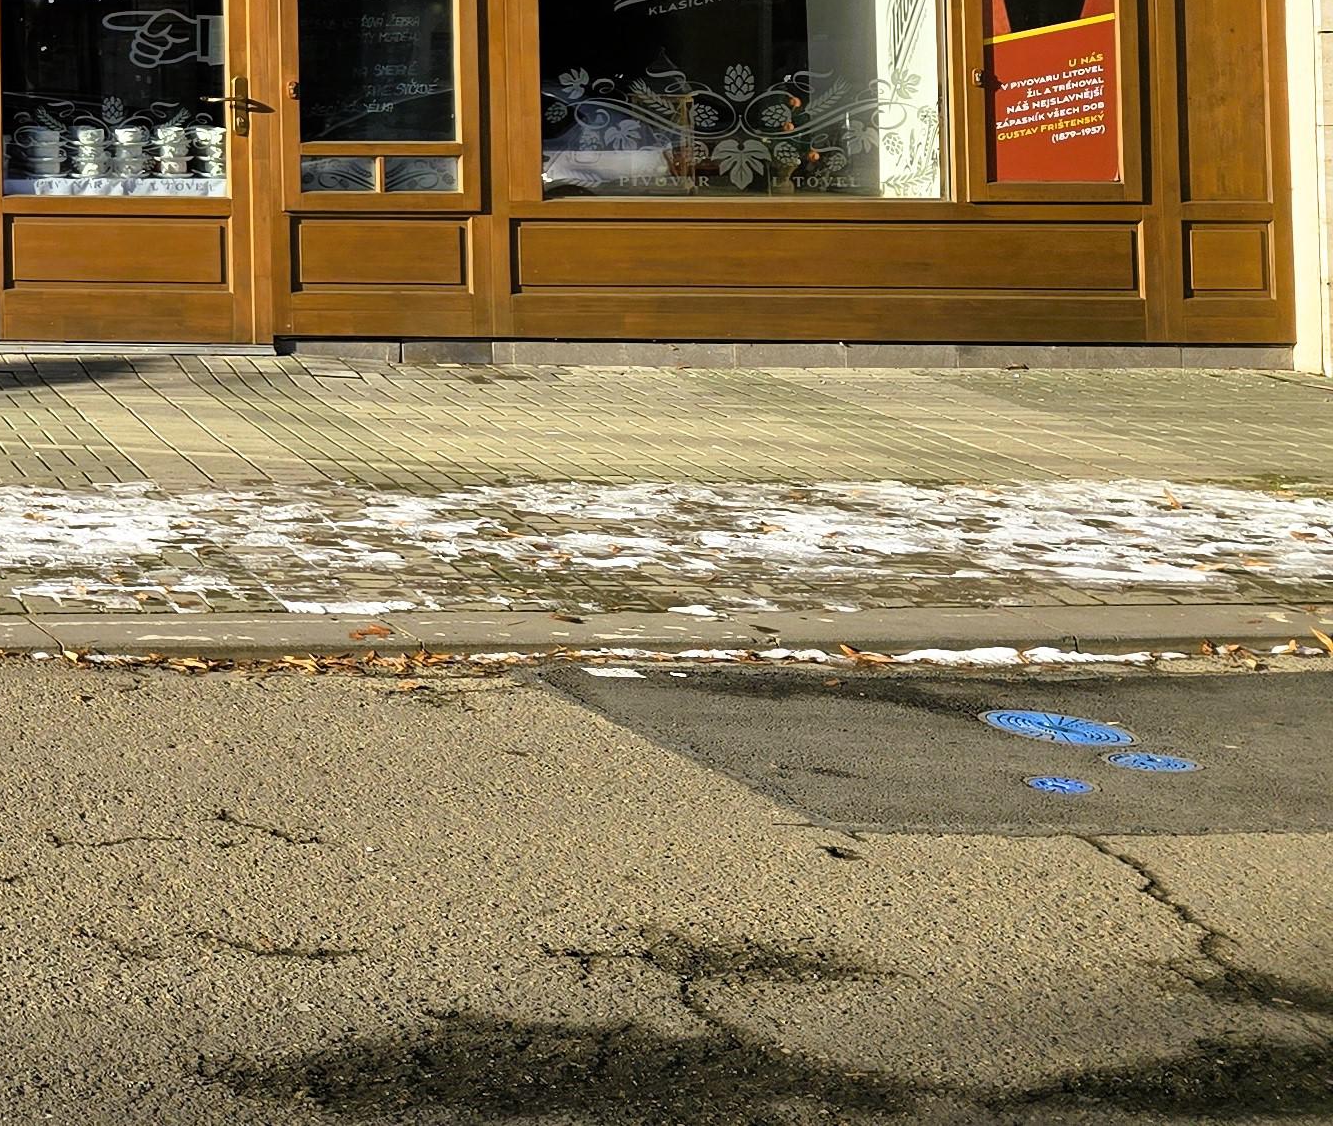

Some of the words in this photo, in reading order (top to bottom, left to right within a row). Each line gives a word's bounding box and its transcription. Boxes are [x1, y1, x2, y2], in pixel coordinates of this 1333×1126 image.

[1068, 59, 1077, 67] U
[1080, 52, 1104, 64] NÁS
[1010, 74, 1060, 89] PIVOVARU
[1062, 65, 1104, 79] LITOVEL
[1026, 88, 1042, 98] ŽIL
[1052, 77, 1104, 92] TRÉNOVAL
[1006, 100, 1030, 114] NÁŠ
[1032, 85, 1104, 109] NEJSLAVNĚJŠÍ
[996, 112, 1046, 130] ZÁPASNÍK
[1047, 106, 1080, 119] VŠECH
[1082, 101, 1105, 112] DOB
[997, 126, 1039, 141] GUSTAV
[1040, 111, 1105, 133] FRIŠTENSKÝ
[772, 176, 861, 188] LTOVEL
